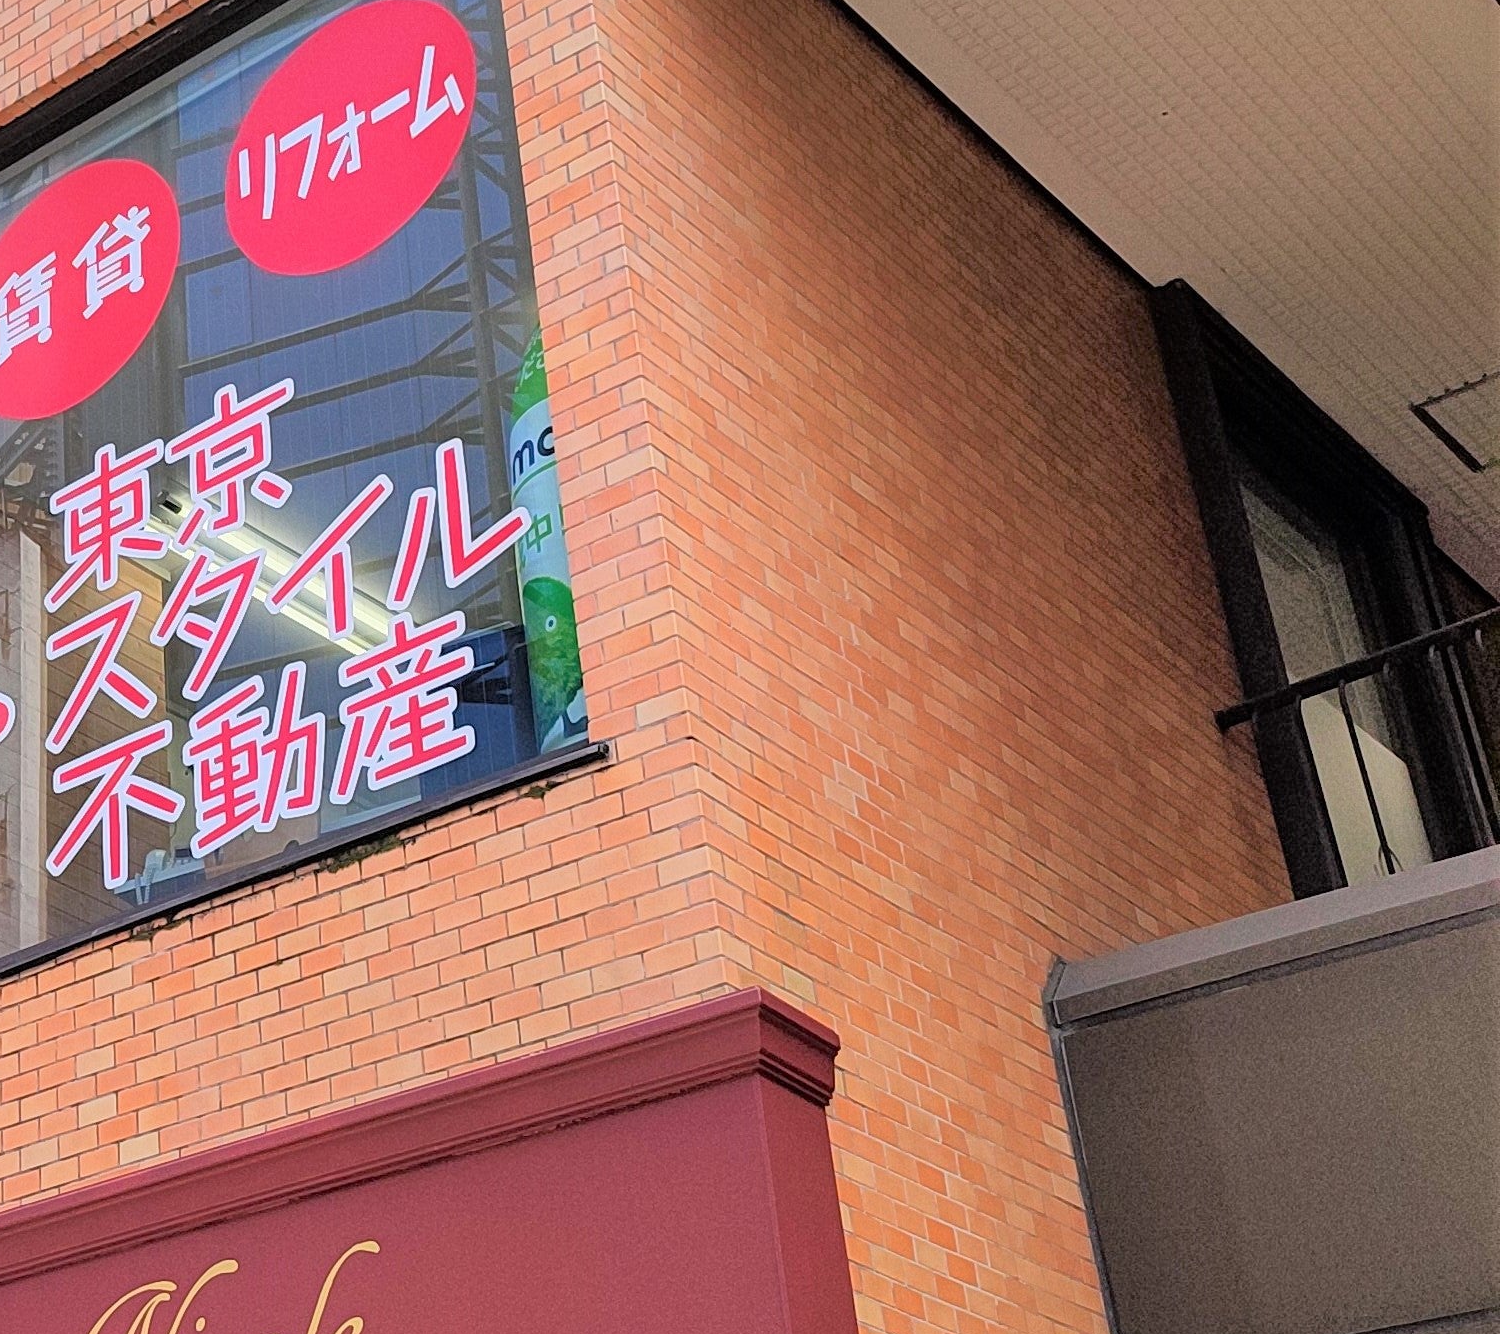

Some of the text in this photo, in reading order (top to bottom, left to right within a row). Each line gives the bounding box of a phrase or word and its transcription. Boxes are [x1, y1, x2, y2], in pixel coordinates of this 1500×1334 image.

[238, 45, 465, 220] リフォーム
[44, 377, 296, 613] 東京
[44, 436, 531, 755] スタイル
[46, 610, 475, 889] 不動産
